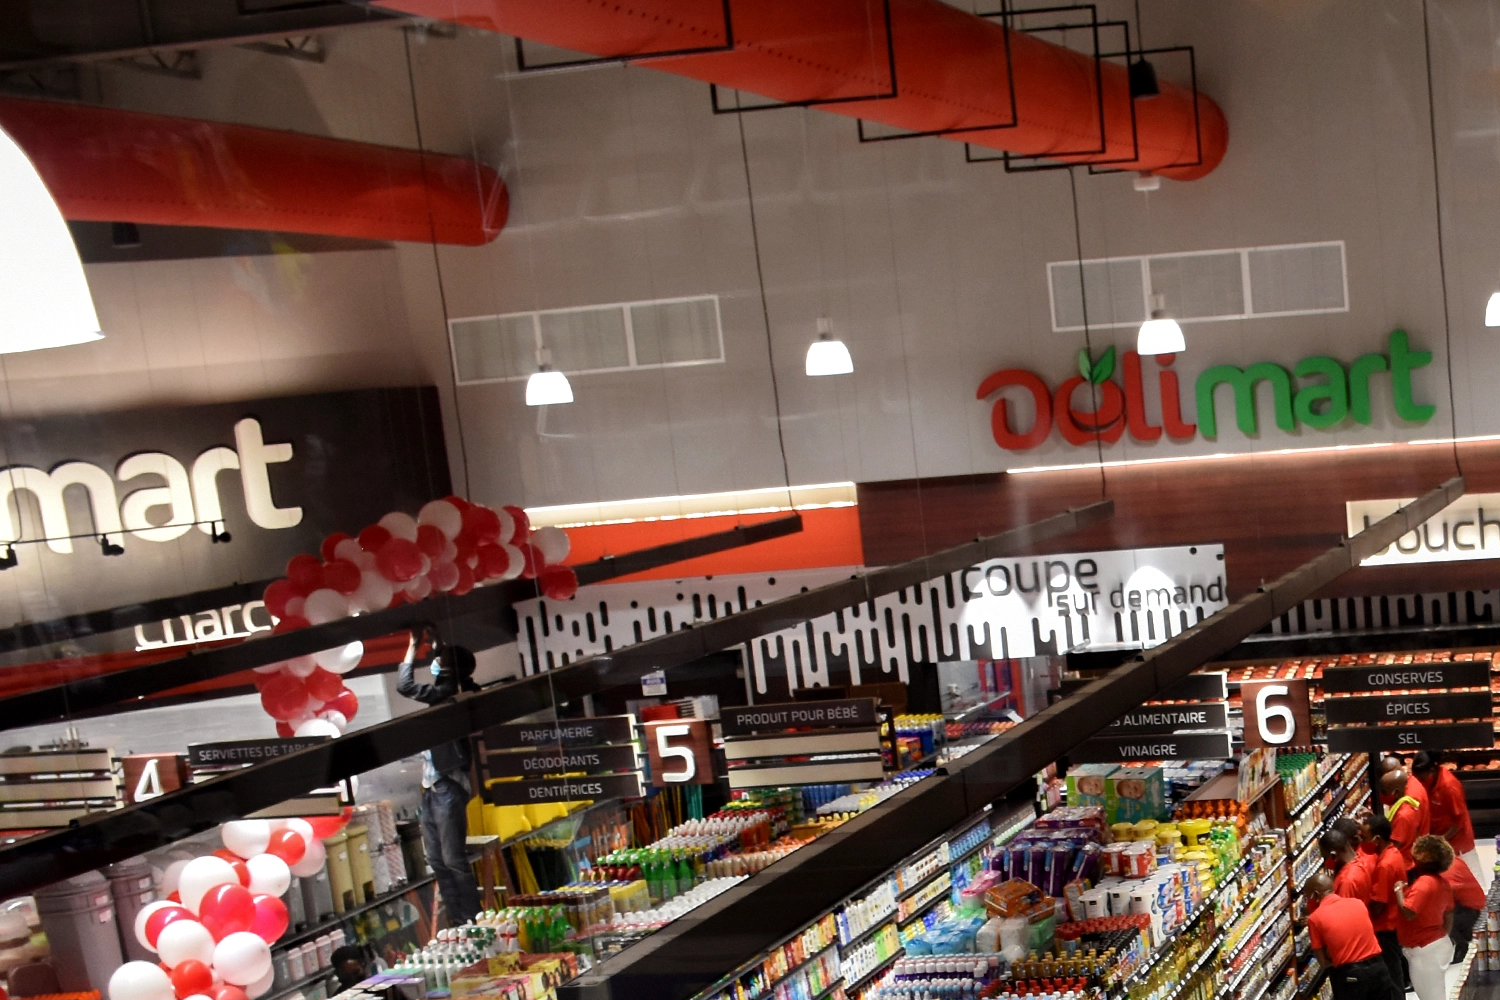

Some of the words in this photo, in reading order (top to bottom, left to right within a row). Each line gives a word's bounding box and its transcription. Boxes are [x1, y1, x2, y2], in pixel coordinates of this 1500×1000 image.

[961, 558, 1099, 607] coupe
[1056, 592, 1101, 617] sur
[1110, 576, 1224, 608] demand
[1367, 671, 1444, 686] CONSERVES
[737, 711, 788, 725] PRODUIT
[791, 709, 824, 721] POUR
[827, 705, 859, 719] BÉBÉ
[1255, 685, 1296, 744] 6
[1386, 702, 1430, 715] ÉPICES
[1123, 711, 1207, 726] ALIMENTAIRE
[520, 726, 594, 741] PARFUMERIE
[1398, 733, 1422, 744] SEL
[199, 746, 263, 761] SERVIETTES
[265, 745, 279, 756] DE
[655, 725, 696, 782] 5
[1119, 744, 1178, 757] VINAIGRE
[523, 754, 600, 770] DÉODORANTS
[528, 783, 602, 798] DENTIFRICES
